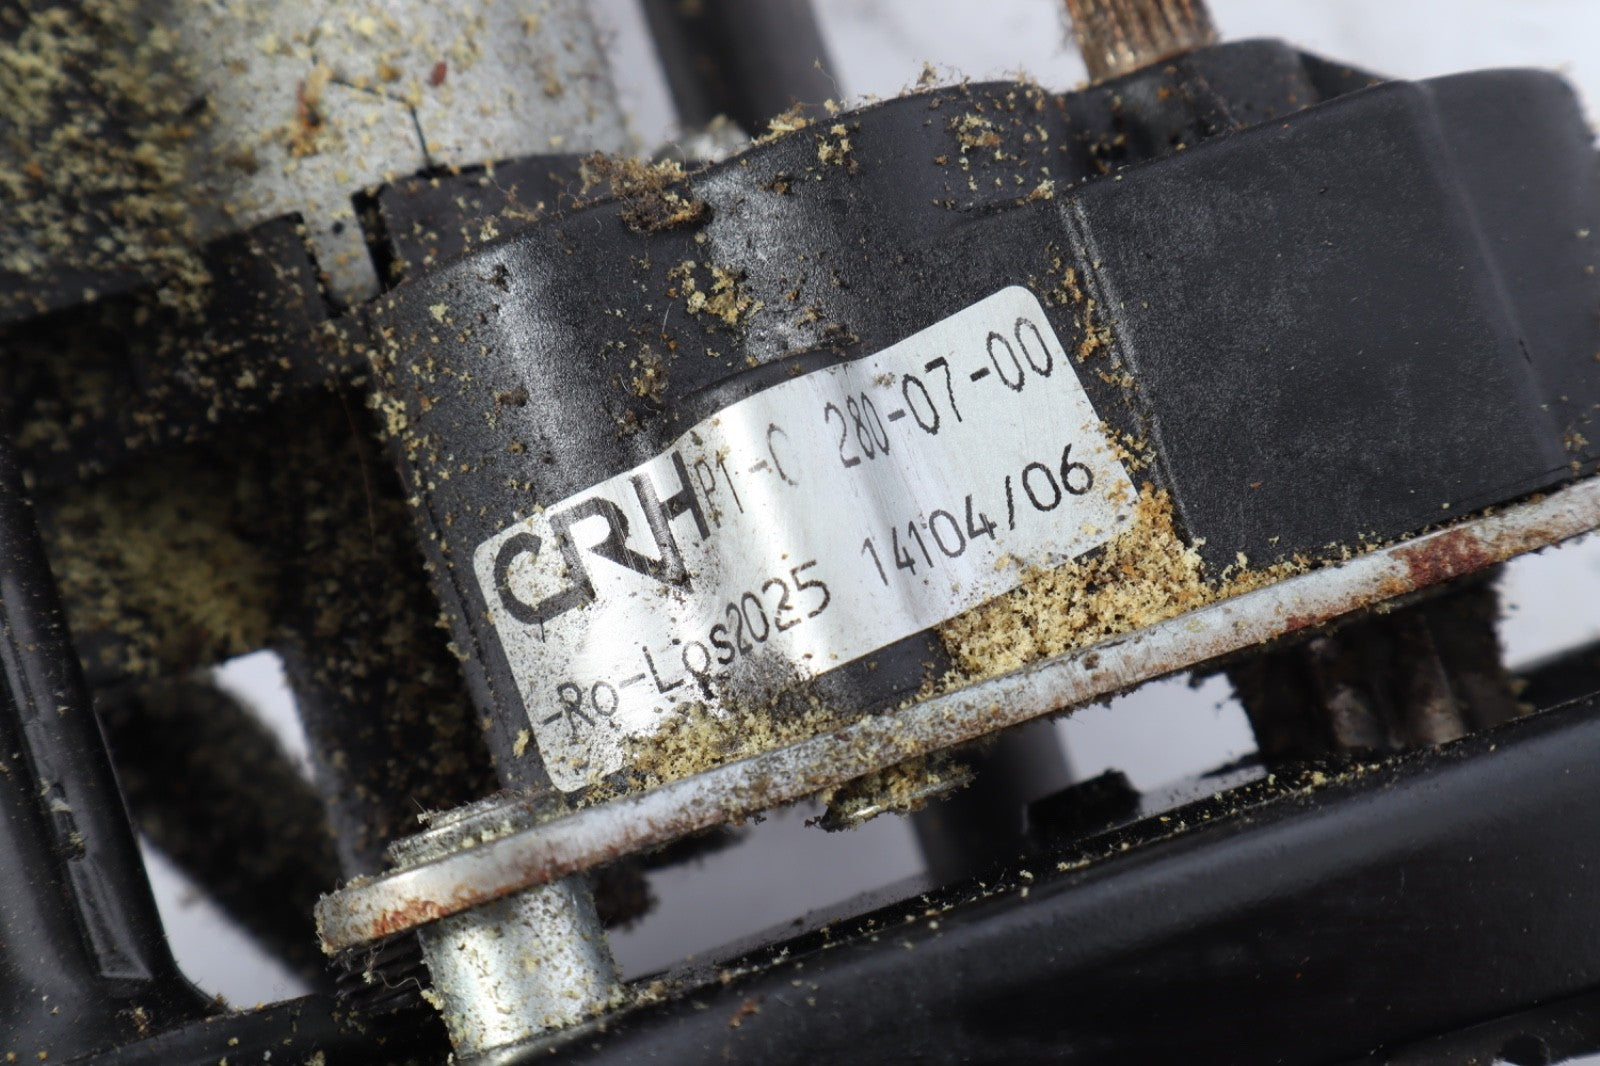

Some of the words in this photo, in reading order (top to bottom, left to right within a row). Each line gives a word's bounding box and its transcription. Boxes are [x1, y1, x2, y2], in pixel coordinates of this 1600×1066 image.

[824, 317, 1054, 468] 280-07-00
[494, 450, 711, 625] CRH
[861, 443, 1094, 586] 14104/06
